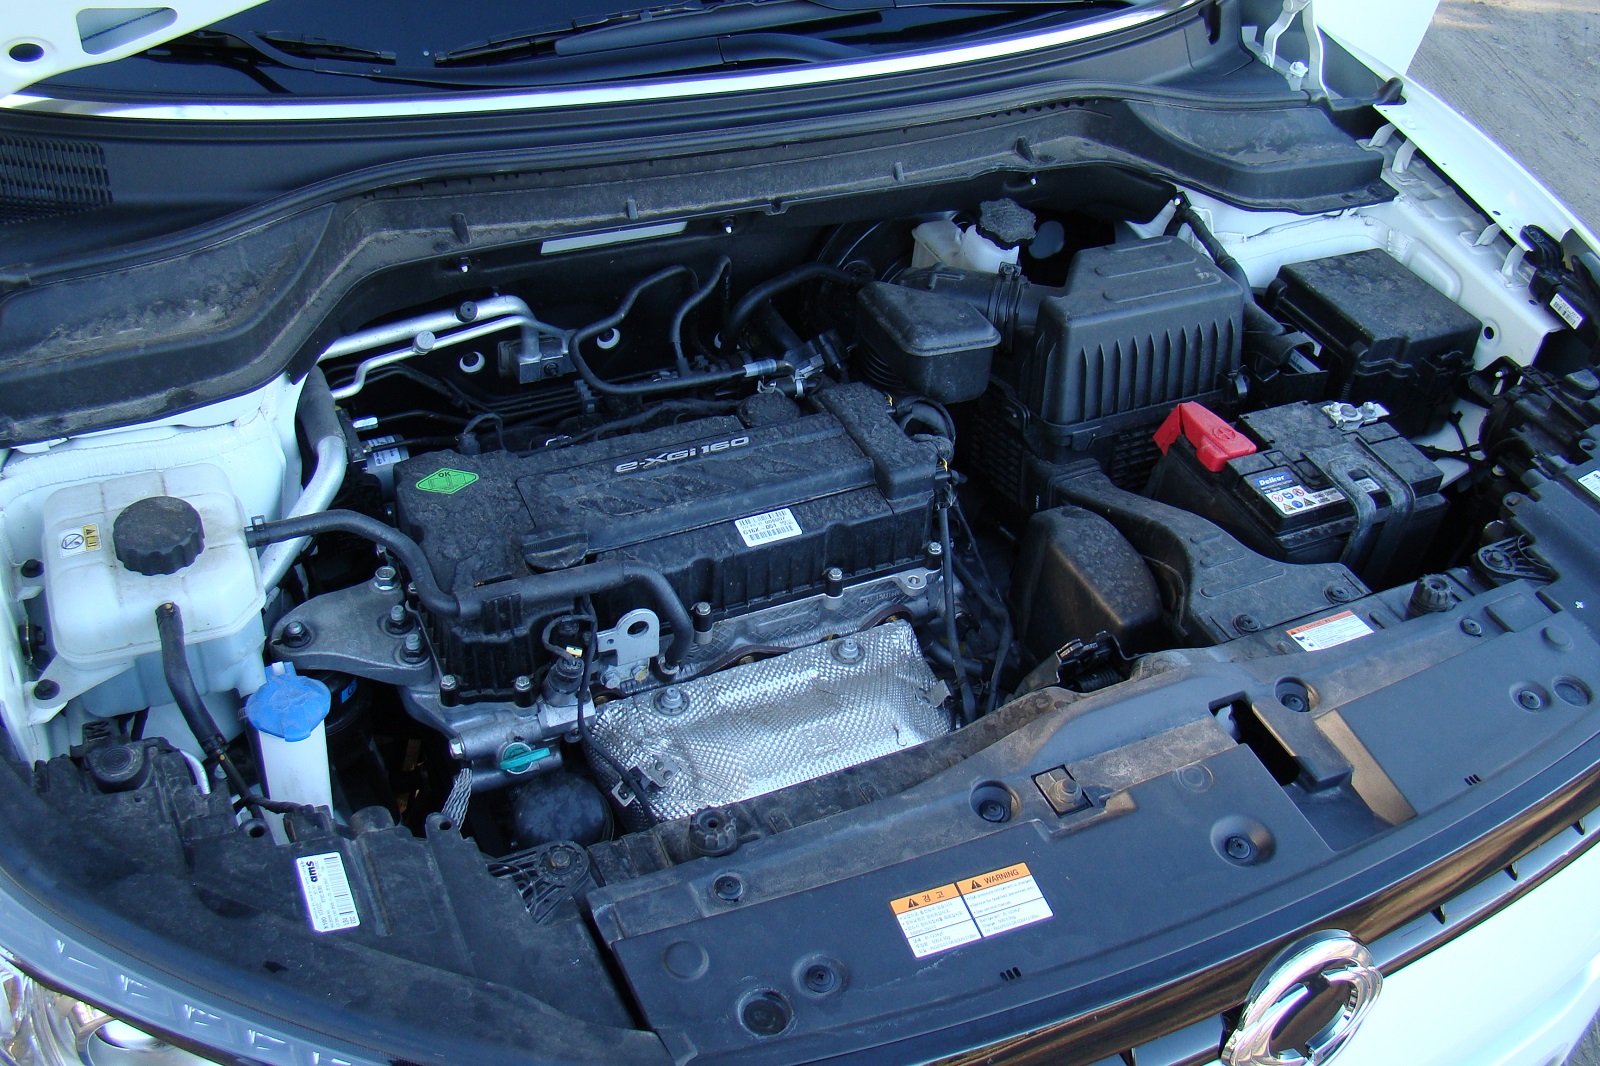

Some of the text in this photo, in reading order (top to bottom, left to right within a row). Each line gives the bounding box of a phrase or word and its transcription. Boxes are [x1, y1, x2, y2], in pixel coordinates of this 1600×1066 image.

[700, 436, 750, 454] 160
[1259, 475, 1285, 485] Delkor
[984, 869, 1020, 884] WARNING
